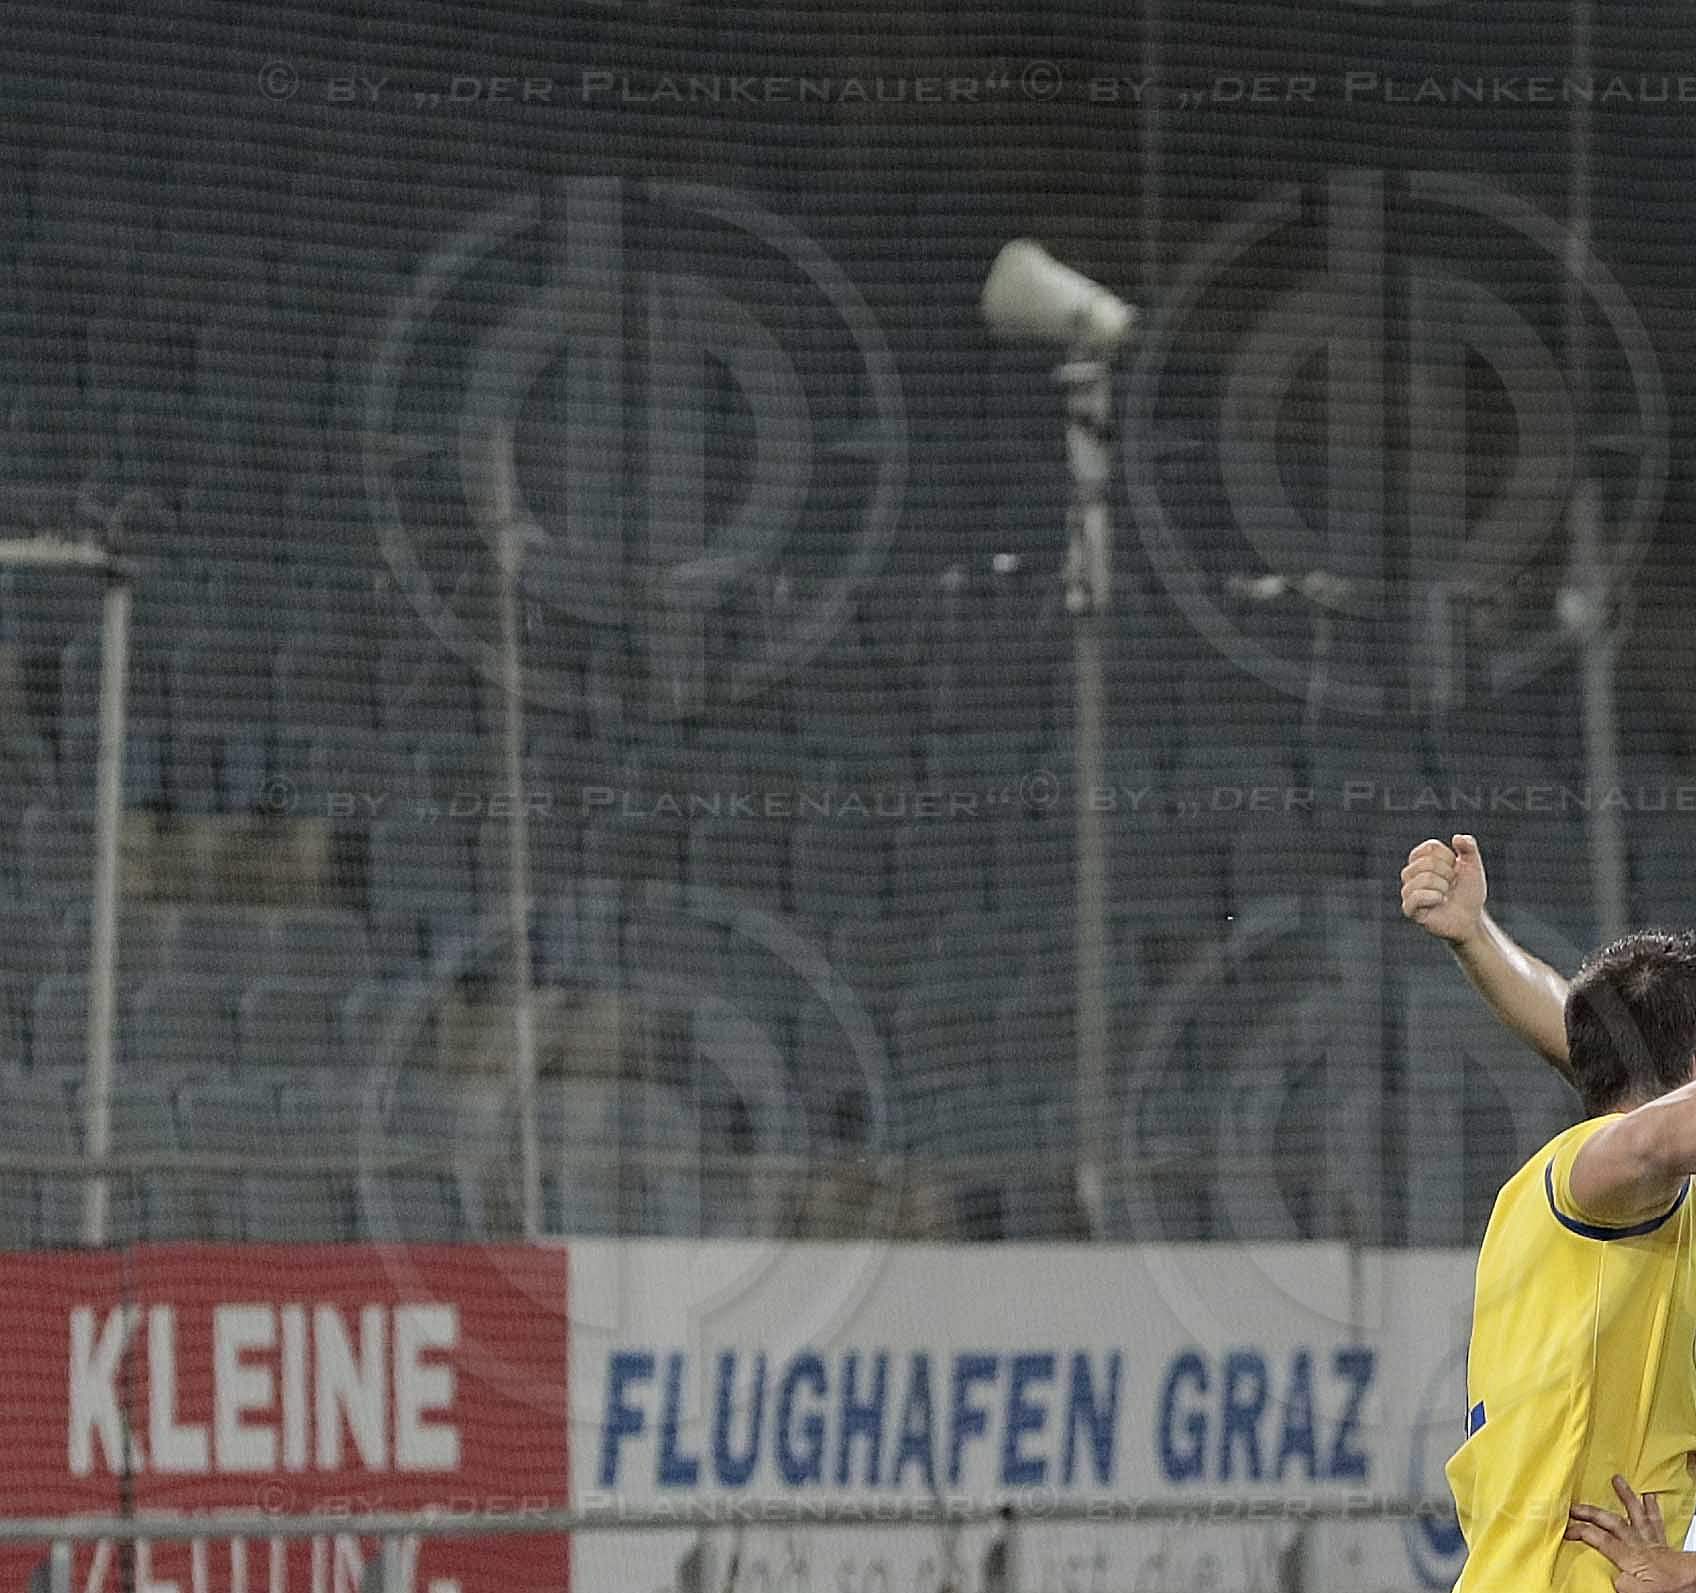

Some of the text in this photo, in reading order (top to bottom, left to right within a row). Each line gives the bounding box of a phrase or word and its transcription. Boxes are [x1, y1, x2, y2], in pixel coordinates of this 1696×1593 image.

[67, 1303, 461, 1476] KLEINE
[601, 1347, 1377, 1488] FLUGHAFEN GRAZ
